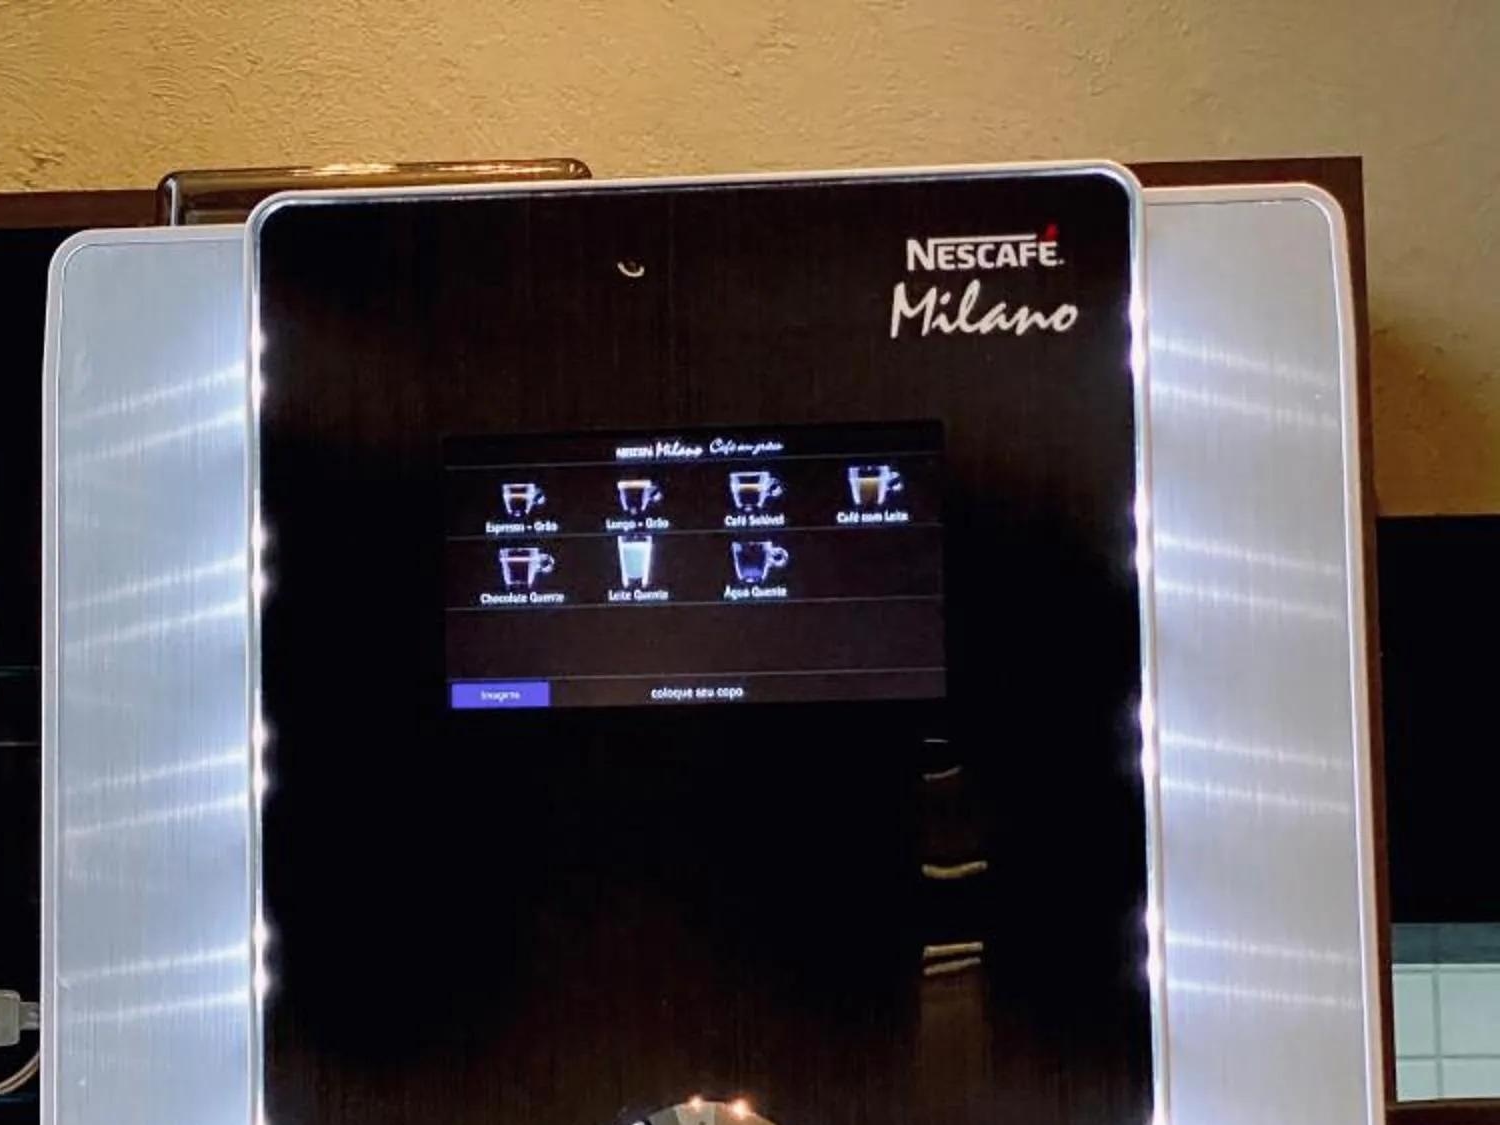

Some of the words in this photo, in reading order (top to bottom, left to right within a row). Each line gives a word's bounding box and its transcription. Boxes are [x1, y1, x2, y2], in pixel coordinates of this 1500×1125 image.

[890, 278, 1078, 339] Milano
[655, 441, 702, 458] Milano
[725, 515, 747, 527] Café
[836, 511, 860, 523] Café
[884, 510, 909, 522] Leite
[651, 687, 692, 700] coloque
[695, 689, 715, 698] seu
[717, 686, 744, 700] copo
